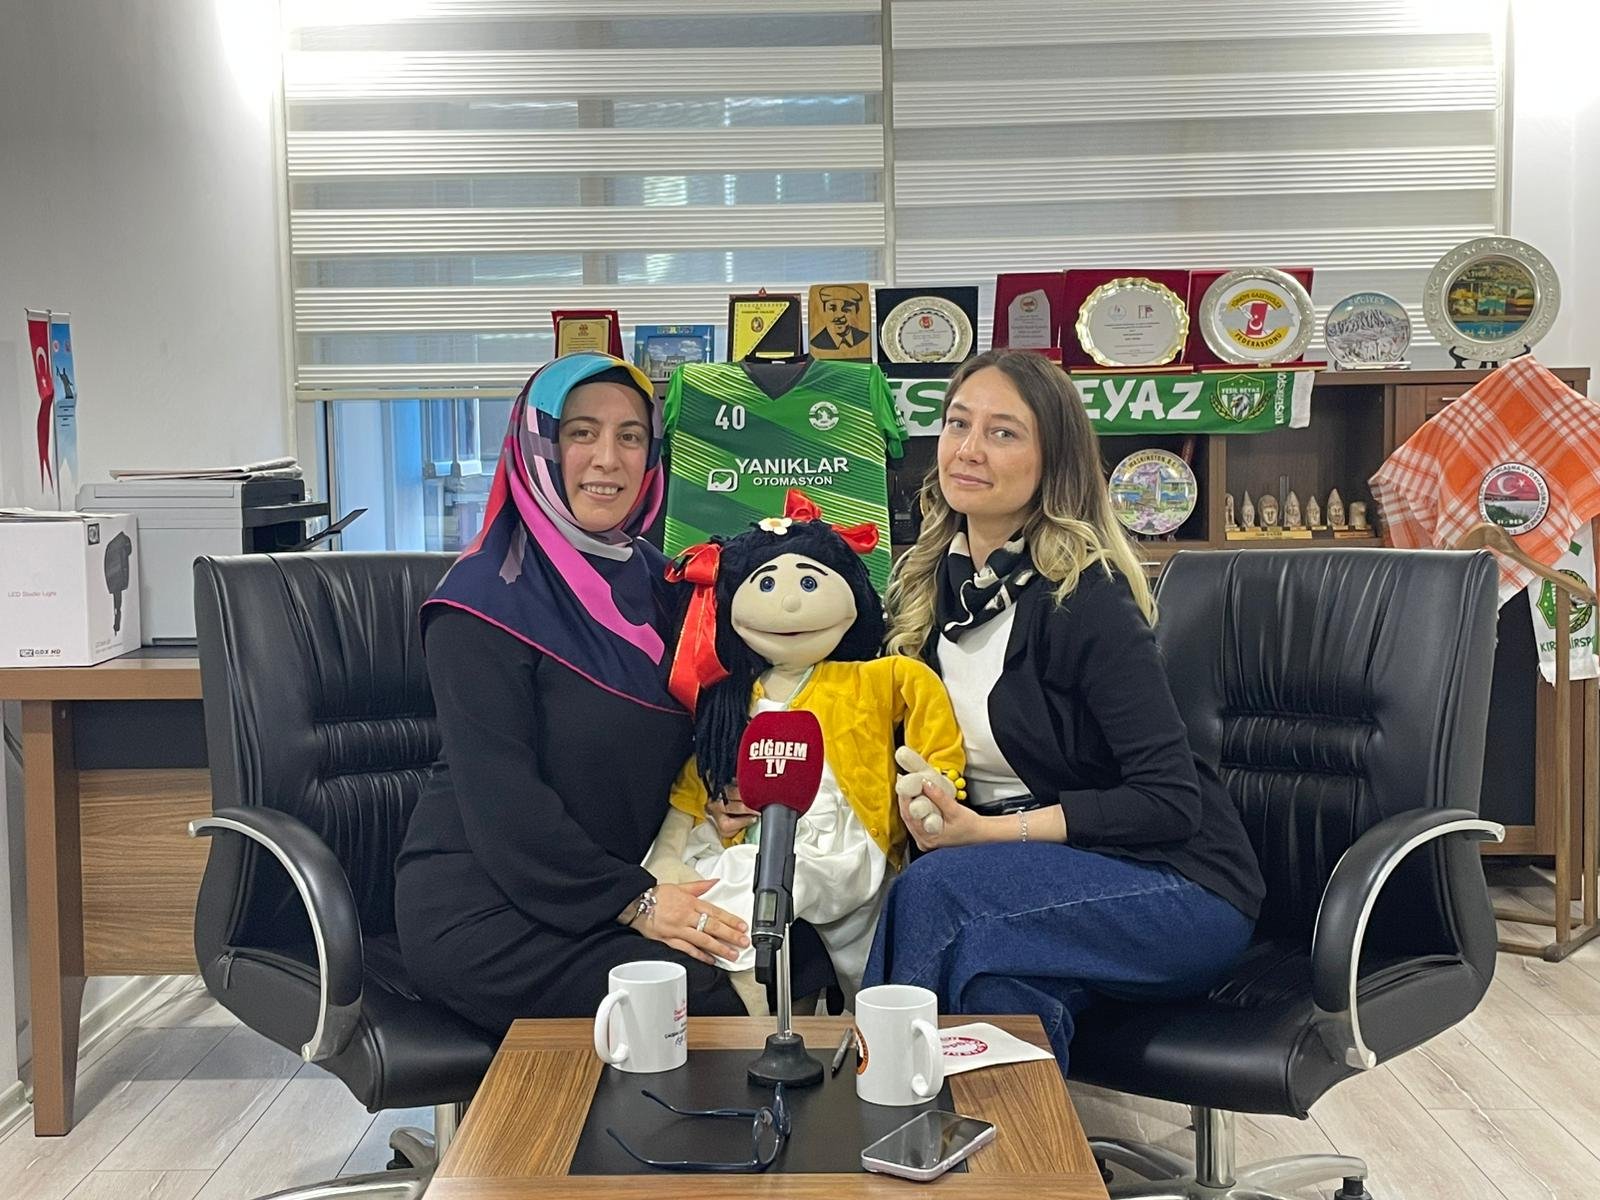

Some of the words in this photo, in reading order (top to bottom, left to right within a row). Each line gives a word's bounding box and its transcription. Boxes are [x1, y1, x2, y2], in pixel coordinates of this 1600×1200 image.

[1072, 379, 1204, 422] EYAZ
[715, 404, 746, 430] 40
[735, 457, 849, 474] YANIKLAR
[753, 476, 833, 486] OTOMASYON
[749, 738, 808, 759] ÇİĞDEM
[766, 759, 787, 775] TV
